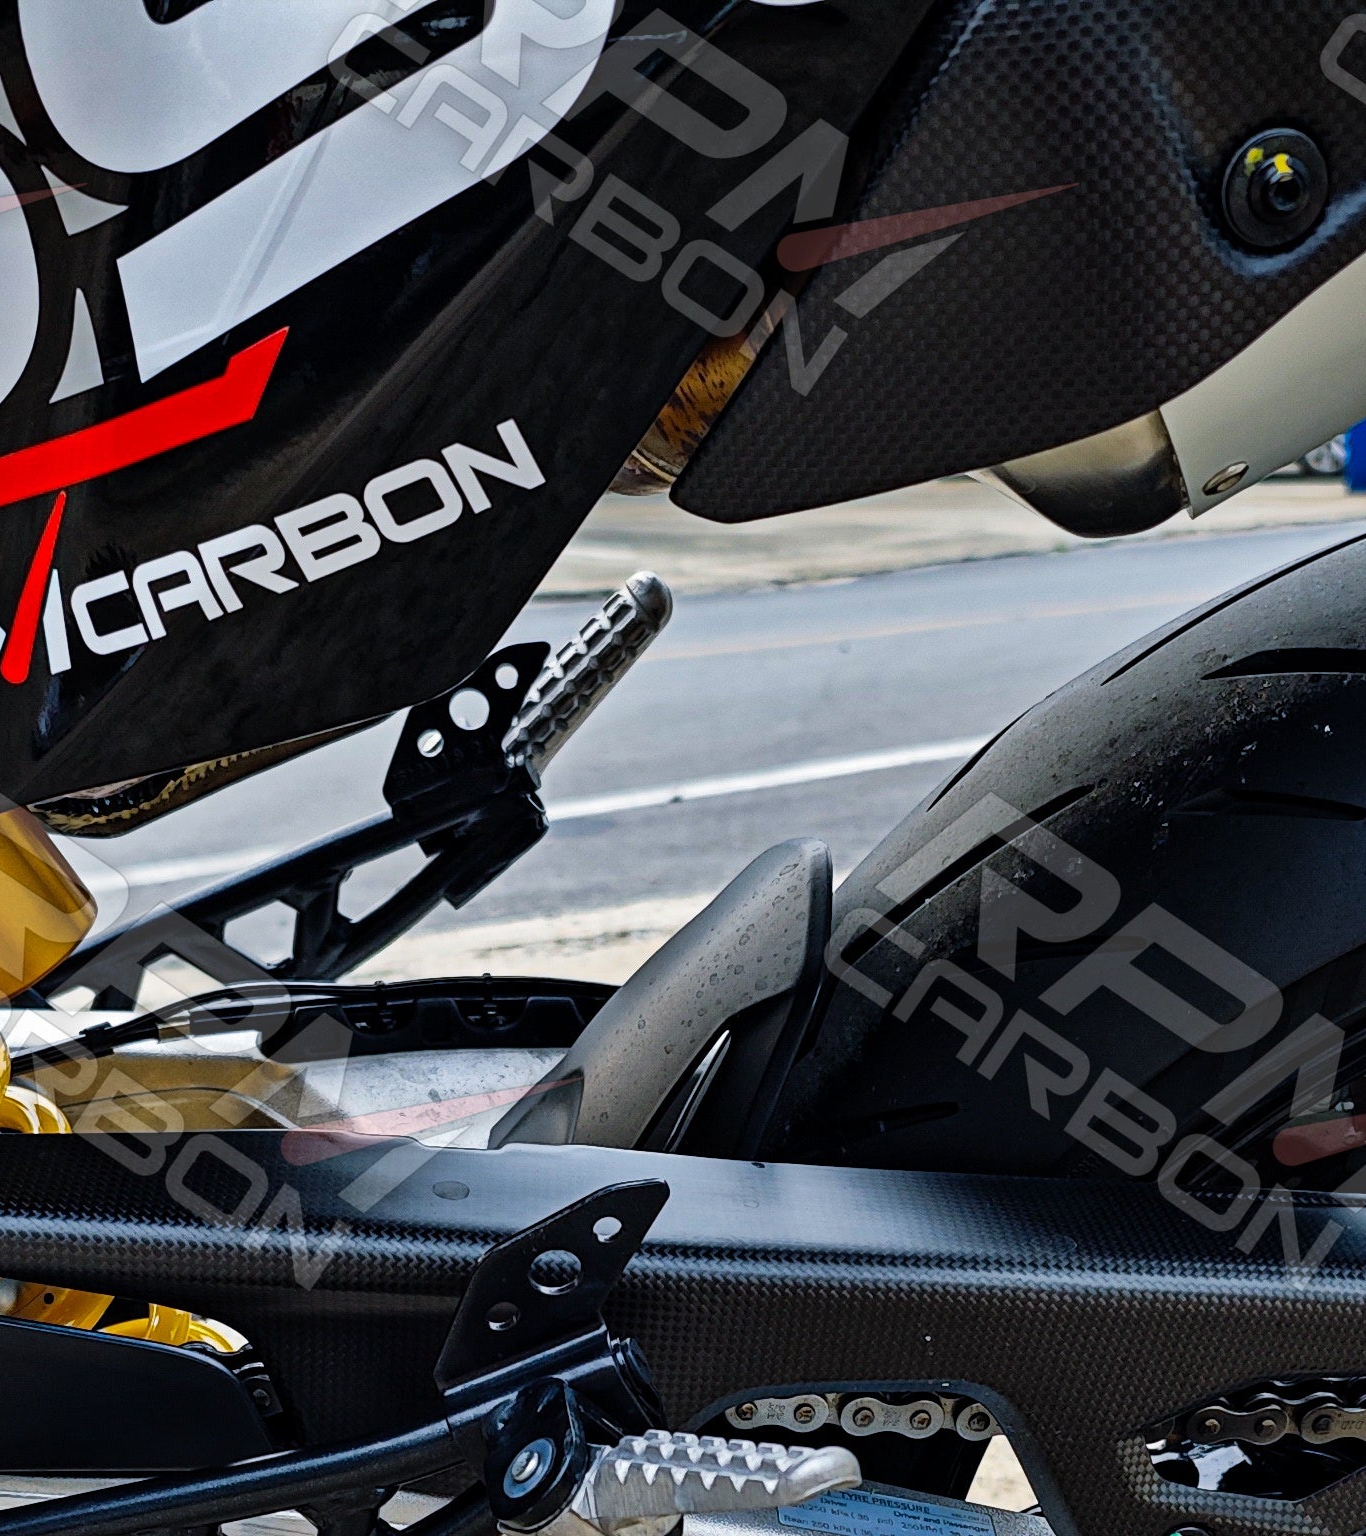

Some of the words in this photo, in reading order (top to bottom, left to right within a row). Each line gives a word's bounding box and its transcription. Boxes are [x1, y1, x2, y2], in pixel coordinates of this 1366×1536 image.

[69, 419, 546, 658] CARBON
[839, 1491, 869, 1504] TYRE
[872, 1496, 930, 1514] PRESSURE
